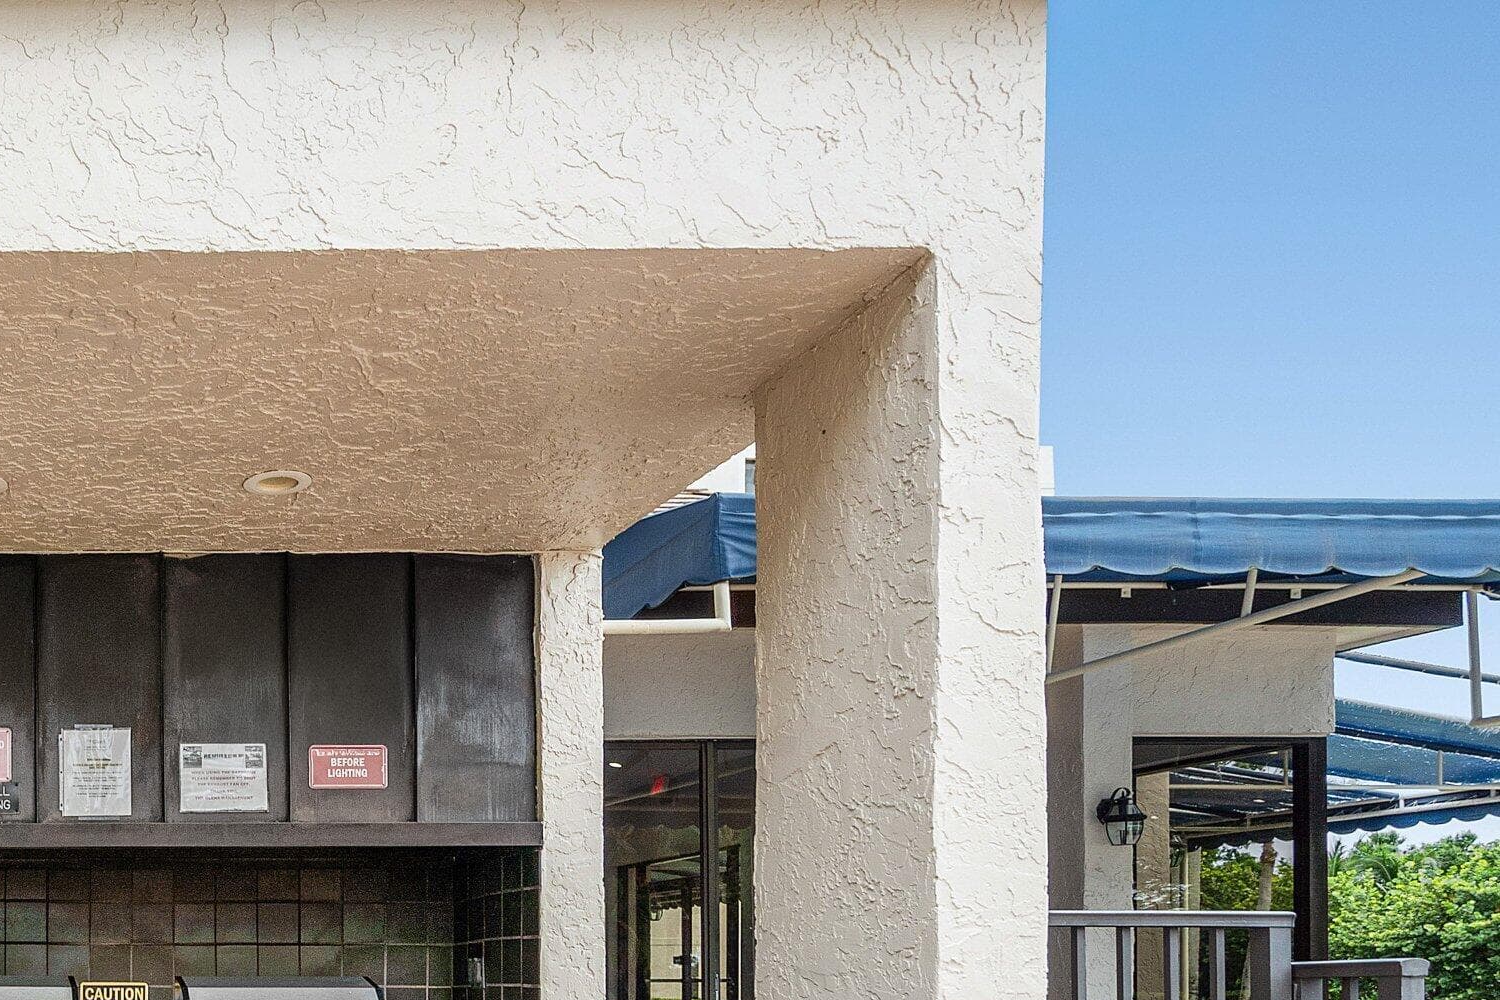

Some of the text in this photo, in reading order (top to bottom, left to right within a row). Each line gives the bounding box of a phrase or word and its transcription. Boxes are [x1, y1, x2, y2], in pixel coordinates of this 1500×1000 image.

[331, 758, 365, 766] BEFORE
[328, 768, 368, 778] LIGHTING
[84, 987, 144, 1000] CAUTION
